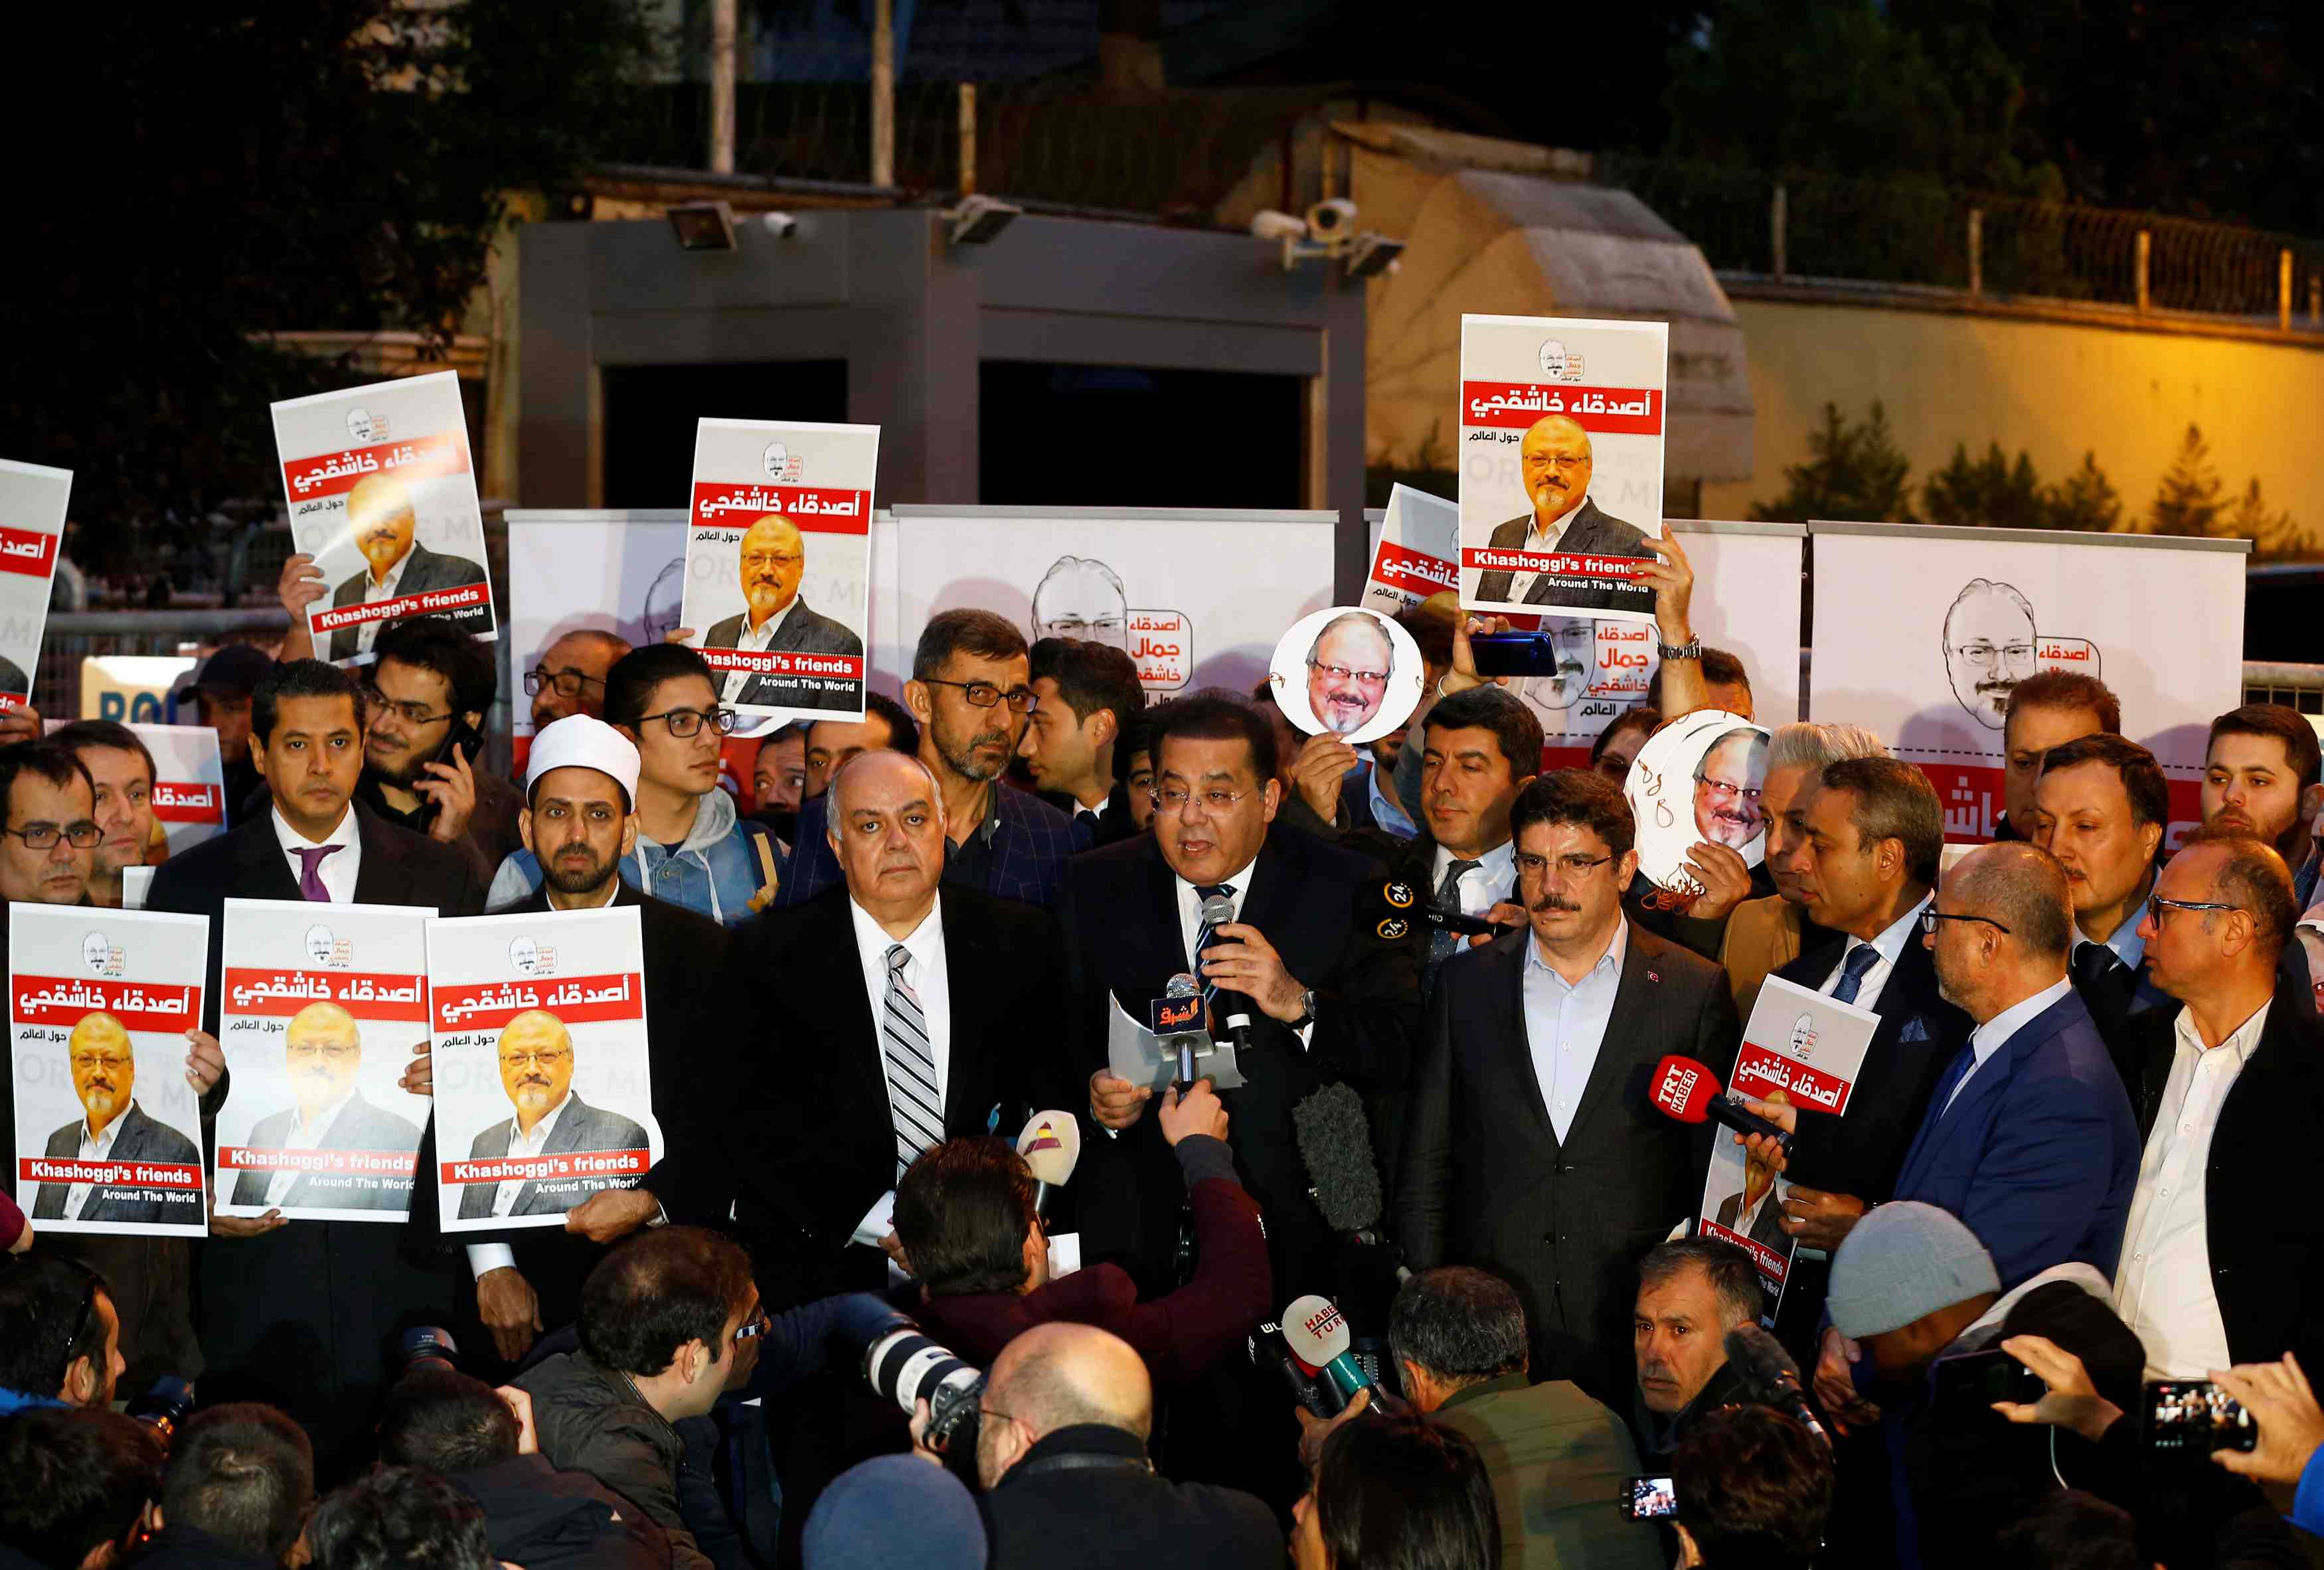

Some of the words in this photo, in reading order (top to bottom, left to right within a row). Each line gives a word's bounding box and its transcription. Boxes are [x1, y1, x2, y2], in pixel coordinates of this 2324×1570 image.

[1471, 385, 1564, 418] خاشقجي
[1571, 389, 1651, 416] أصدقاء
[1469, 431, 1497, 441] العالم
[1499, 432, 1519, 443] حول
[293, 451, 379, 493] خاشقجي
[298, 502, 323, 515] العالم
[325, 499, 345, 510] حول
[699, 485, 782, 518] خاشقجي
[788, 490, 861, 516] أصدقاء
[696, 531, 720, 542] العالم
[722, 532, 740, 543] حول
[1474, 550, 1580, 574] Khashoggi's
[1547, 576, 1588, 590] Around
[1592, 580, 1613, 590] The
[1372, 588, 1398, 599] العالم
[321, 598, 418, 627] Khashoggi's
[422, 588, 479, 609] friends
[453, 605, 484, 620] World
[1129, 615, 1180, 631] أصدقاء
[1597, 625, 1649, 642] أصدقاء
[1131, 637, 1180, 662] جمال
[1599, 647, 1649, 672] جمال
[2038, 642, 2090, 661] أصدقاء
[795, 658, 853, 674] friends
[760, 676, 797, 688] Around
[801, 680, 821, 689] The
[824, 680, 855, 692] World
[1580, 702, 1616, 716] العالم
[1392, 884, 1407, 902] 24
[20, 980, 106, 1014] خاشقجي
[232, 971, 331, 1006] خاشقجي
[339, 976, 422, 1003] أصدقاء
[546, 975, 629, 1006] أصدقاء
[112, 987, 189, 1014] أصدقاء
[441, 982, 539, 1023] خاشقجي
[20, 1029, 45, 1040] العالم
[230, 1020, 260, 1030] العالم
[262, 1022, 284, 1033] حول
[48, 1030, 66, 1042] حول
[442, 1035, 470, 1048] العالم
[473, 1035, 495, 1047] حول
[1739, 1056, 1791, 1088] خاشقجي
[1657, 1063, 1684, 1104] TRT
[1673, 1071, 1697, 1113] HABER
[1790, 1073, 1845, 1108] أصدقاء
[230, 1148, 344, 1170] Khashoggi's
[350, 1155, 415, 1171] friends
[454, 1157, 568, 1180] Khashoggi's
[572, 1154, 639, 1172] friends
[31, 1161, 131, 1182] Khashoggi's
[135, 1166, 192, 1183] friends
[309, 1176, 353, 1188] Around
[356, 1178, 378, 1189] The
[535, 1181, 578, 1194] Around
[581, 1179, 604, 1191] The
[102, 1189, 140, 1201] Around
[143, 1190, 163, 1202] The
[166, 1191, 197, 1204] World
[1760, 1251, 1784, 1276] friends
[1305, 1304, 1337, 1330] HABE
[1313, 1316, 1344, 1339] TUR
